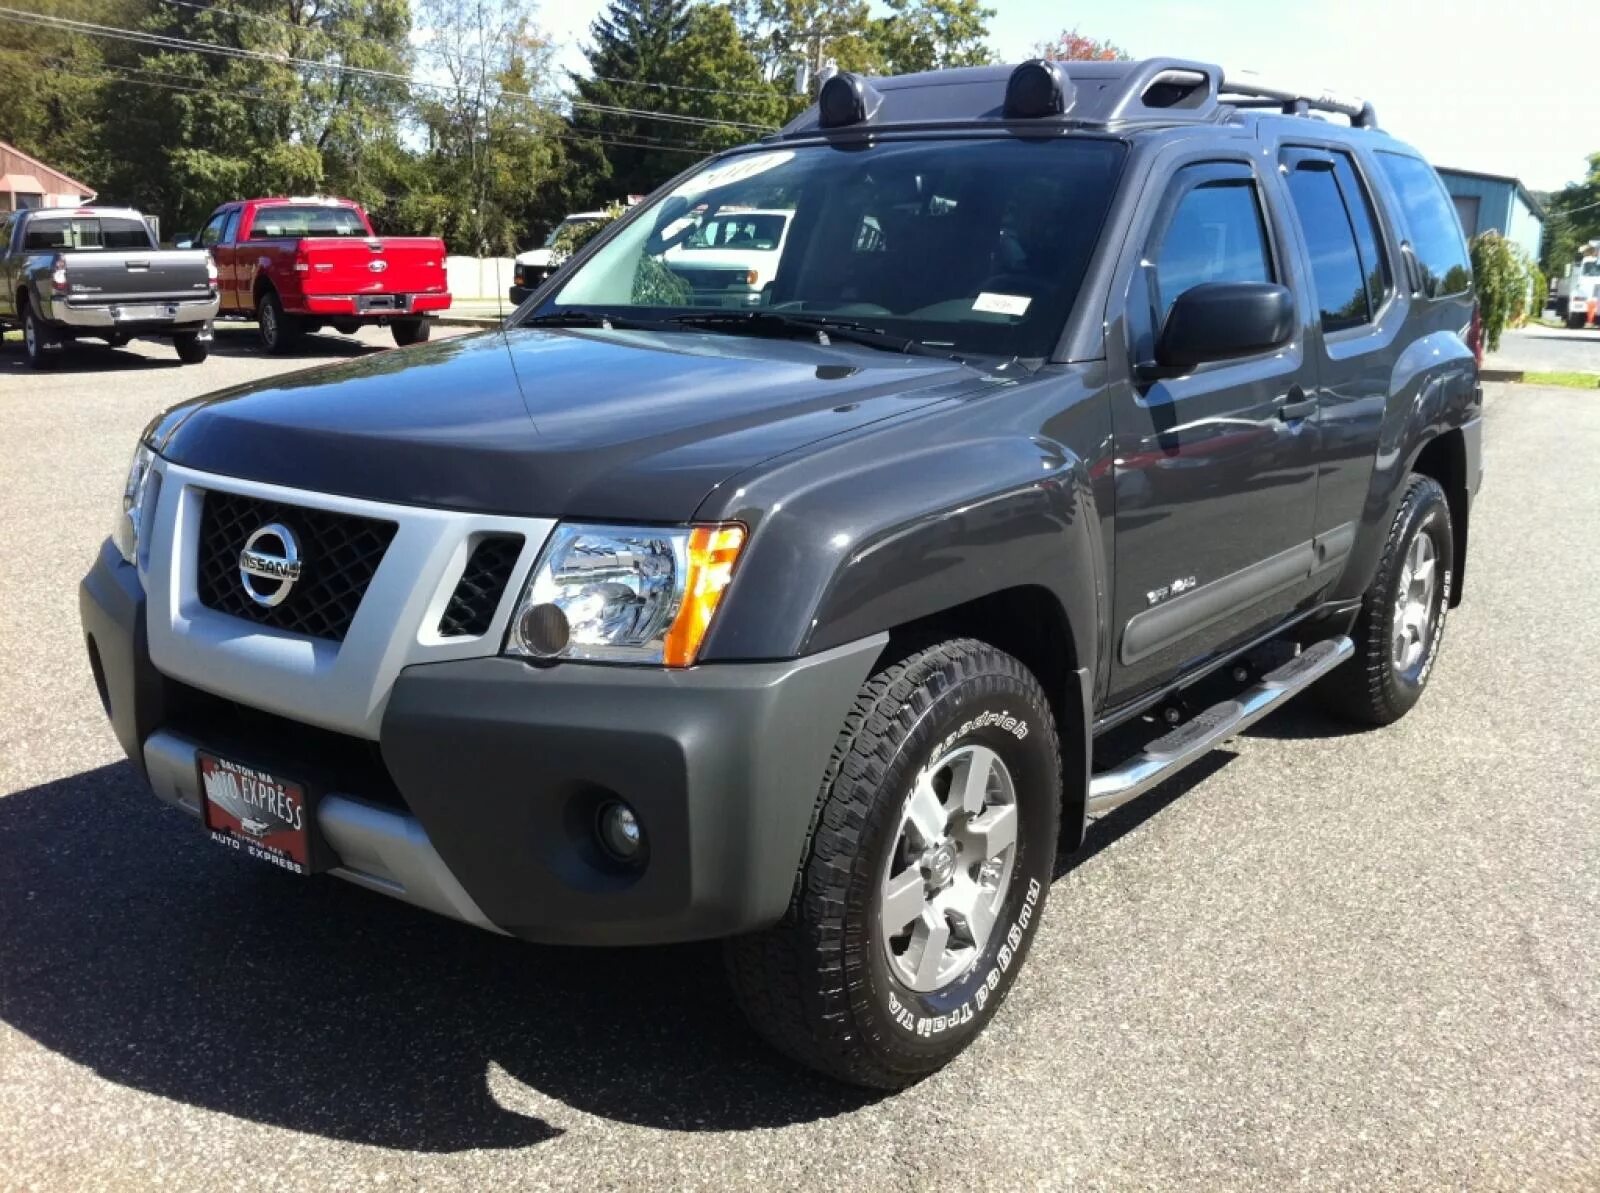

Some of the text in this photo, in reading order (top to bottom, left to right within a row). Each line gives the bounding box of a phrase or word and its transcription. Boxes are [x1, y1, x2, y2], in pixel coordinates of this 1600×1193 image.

[241, 553, 294, 577] NISSAN
[241, 775, 302, 830] EXPRESS
[211, 832, 302, 874] AUTO EXPRESS
[888, 878, 1040, 1037] Rugged Trail T/A
